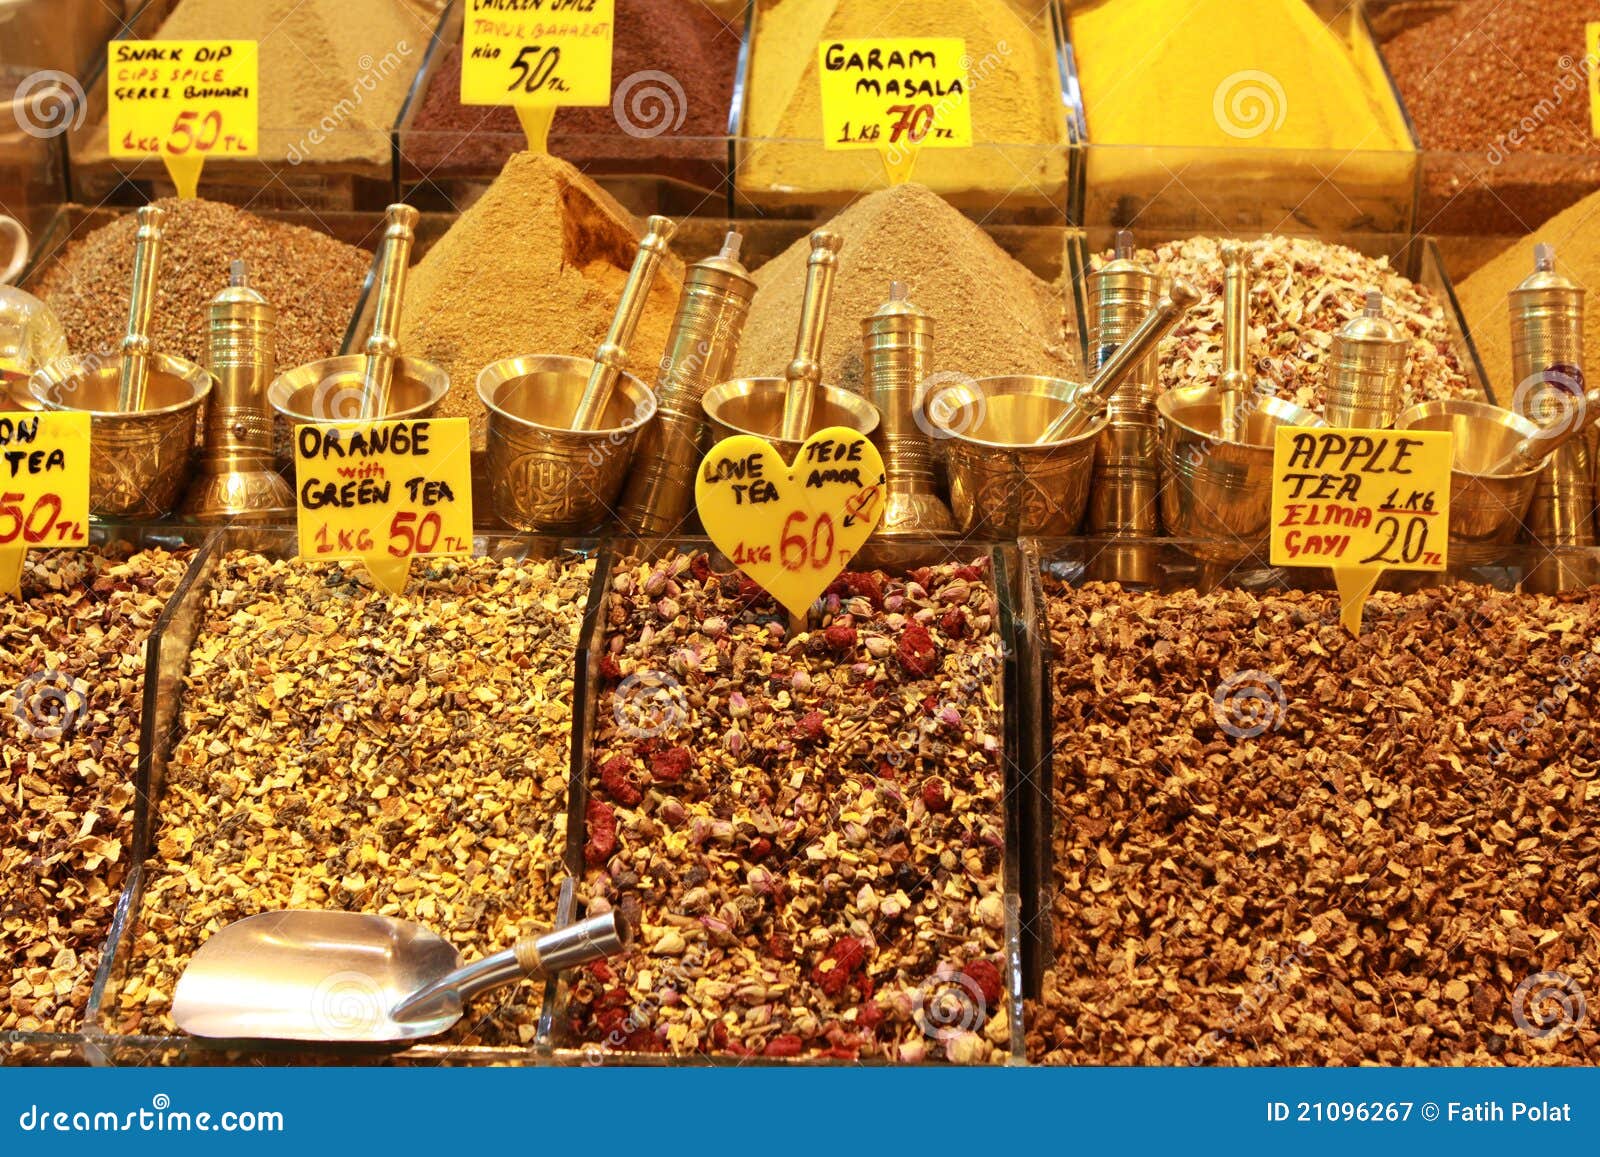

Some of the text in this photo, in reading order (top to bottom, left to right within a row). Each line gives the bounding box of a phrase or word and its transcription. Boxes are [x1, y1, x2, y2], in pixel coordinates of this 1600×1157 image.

[116, 45, 233, 62] SNACK DIP
[825, 43, 936, 71] GARAM
[117, 68, 225, 82] CIPS SPICE
[508, 46, 560, 93] 50
[856, 77, 963, 98] MASALA
[122, 110, 248, 155] 1KG 50 TL
[886, 103, 935, 143] 70
[935, 127, 955, 139] TL
[299, 421, 431, 460] ORANGE
[1287, 432, 1424, 475] APPLE
[4, 448, 65, 478] TEA
[336, 461, 385, 479] with
[703, 453, 764, 484] LOVE
[806, 467, 864, 489] AMOR
[301, 476, 455, 509] GREEN TEA
[731, 479, 780, 505] TEA
[1282, 473, 1362, 502] TEA
[0, 492, 84, 543] 50 TL
[1278, 504, 1373, 529] ELMA
[314, 511, 468, 558] 1KG 50 TL
[732, 540, 772, 565] 1KG
[780, 510, 835, 572] 60
[1285, 530, 1351, 559] ÇAYI
[1359, 515, 1443, 565] 20 TL
